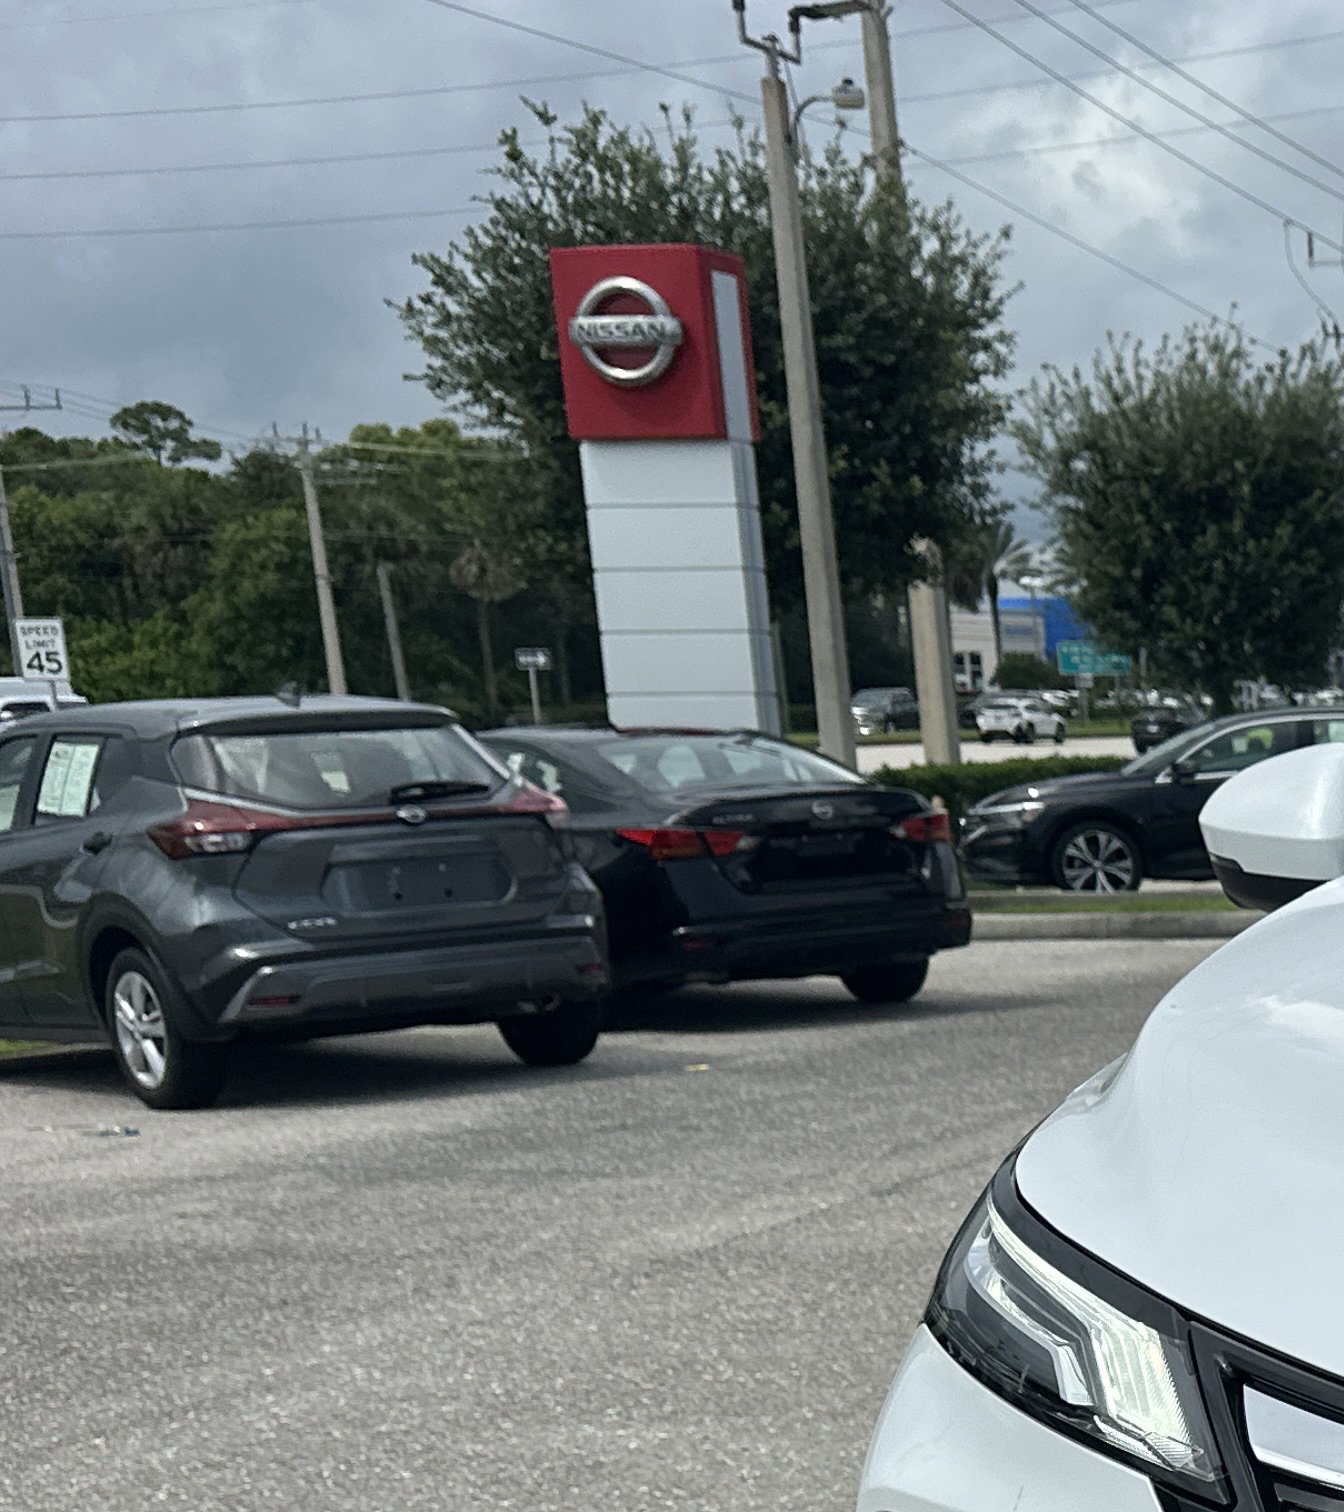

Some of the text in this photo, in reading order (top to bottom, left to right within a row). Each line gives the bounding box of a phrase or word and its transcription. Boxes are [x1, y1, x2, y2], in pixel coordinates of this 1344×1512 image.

[576, 320, 666, 341] NISSAN
[20, 626, 59, 637] SPEED
[27, 651, 63, 674] 45
